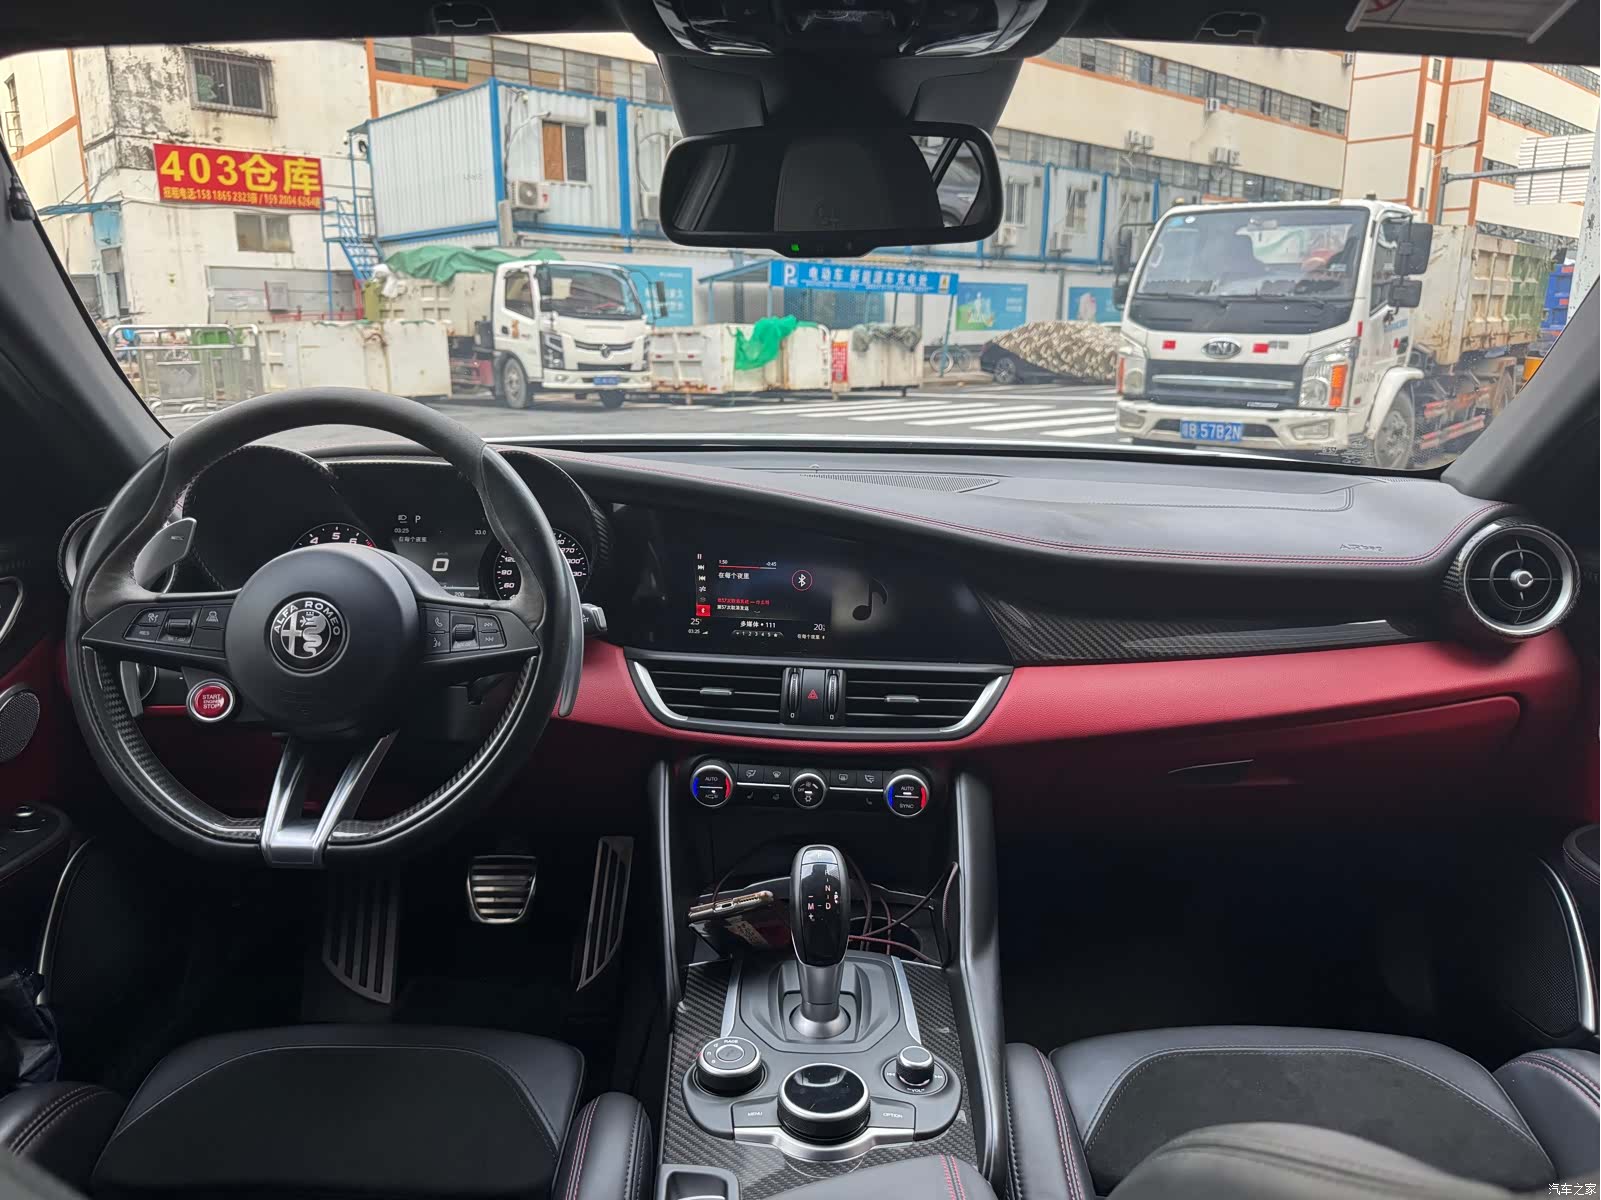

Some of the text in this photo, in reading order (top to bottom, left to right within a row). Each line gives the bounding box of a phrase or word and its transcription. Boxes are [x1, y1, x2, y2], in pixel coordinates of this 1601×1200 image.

[160, 151, 321, 195] 403仓库
[332, 532, 341, 540] 5
[273, 600, 341, 636] ALFA ROMEO
[825, 884, 831, 892] N
[808, 902, 832, 910] M D
